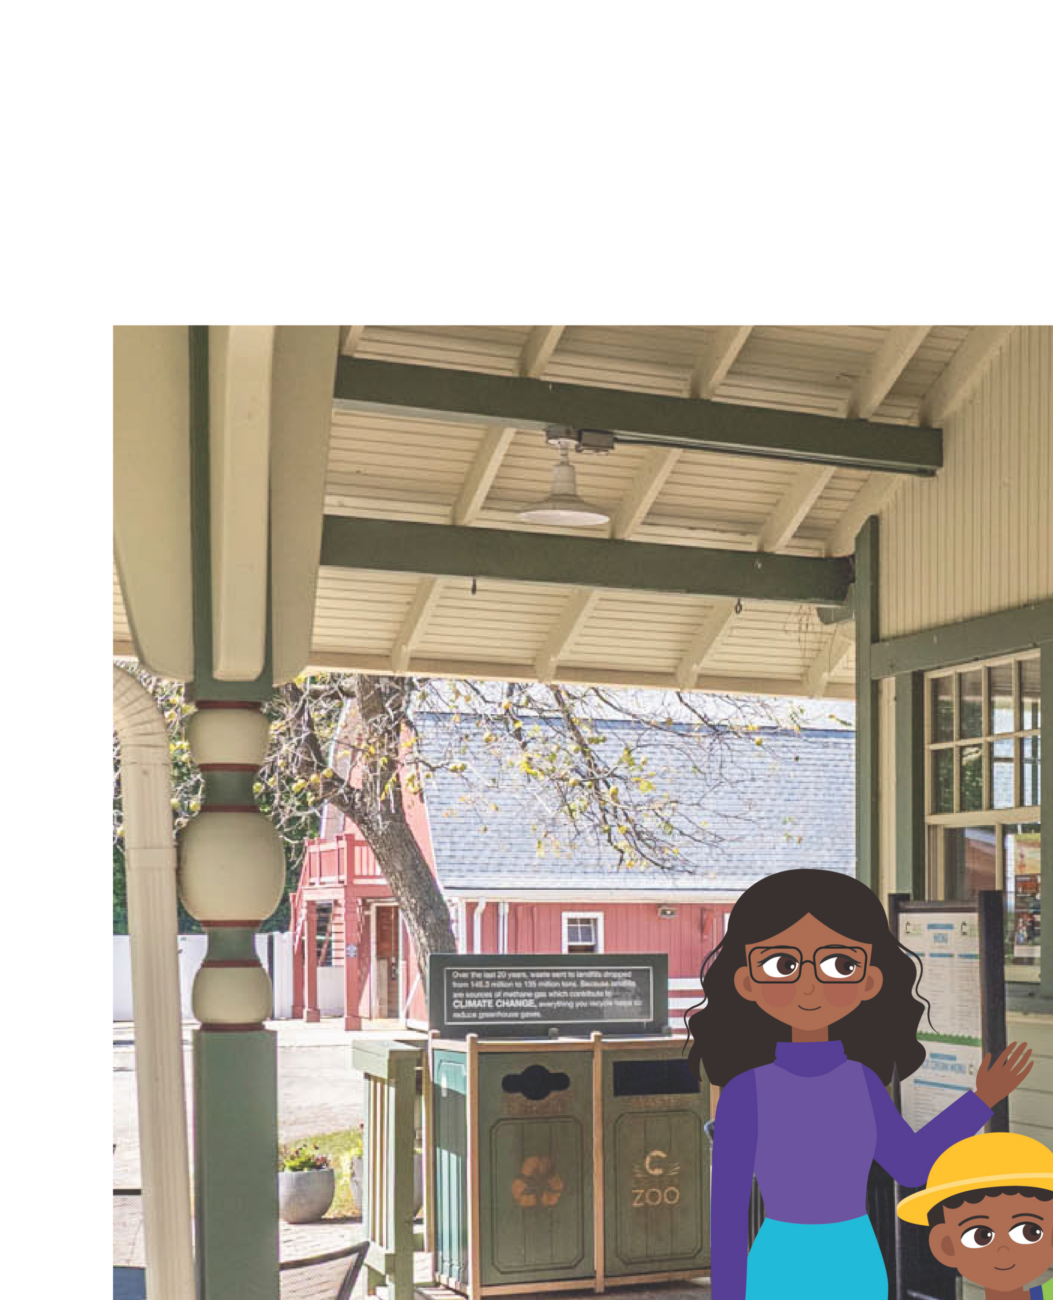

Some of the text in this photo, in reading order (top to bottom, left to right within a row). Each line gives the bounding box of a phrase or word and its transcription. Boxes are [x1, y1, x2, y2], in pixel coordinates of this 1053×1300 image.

[452, 970, 469, 979] Over
[470, 971, 483, 979] the
[483, 971, 496, 979] last
[497, 970, 507, 979] 20
[507, 971, 529, 981] years,
[530, 971, 551, 979] waste
[551, 971, 567, 979] sent
[576, 970, 602, 978] landfills
[603, 970, 633, 980] dropped
[452, 981, 469, 989] from
[491, 980, 514, 989] million
[514, 981, 523, 989] to
[537, 980, 561, 988] million
[452, 990, 613, 1000] are sources of methane gas which contribute to
[452, 999, 494, 1009] CLIMATE
[538, 1000, 575, 1010] everything
[575, 1001, 588, 1010] you
[452, 1011, 477, 1019] reduce
[478, 1011, 519, 1020] greenhouse
[632, 1186, 681, 1208] ZOO
